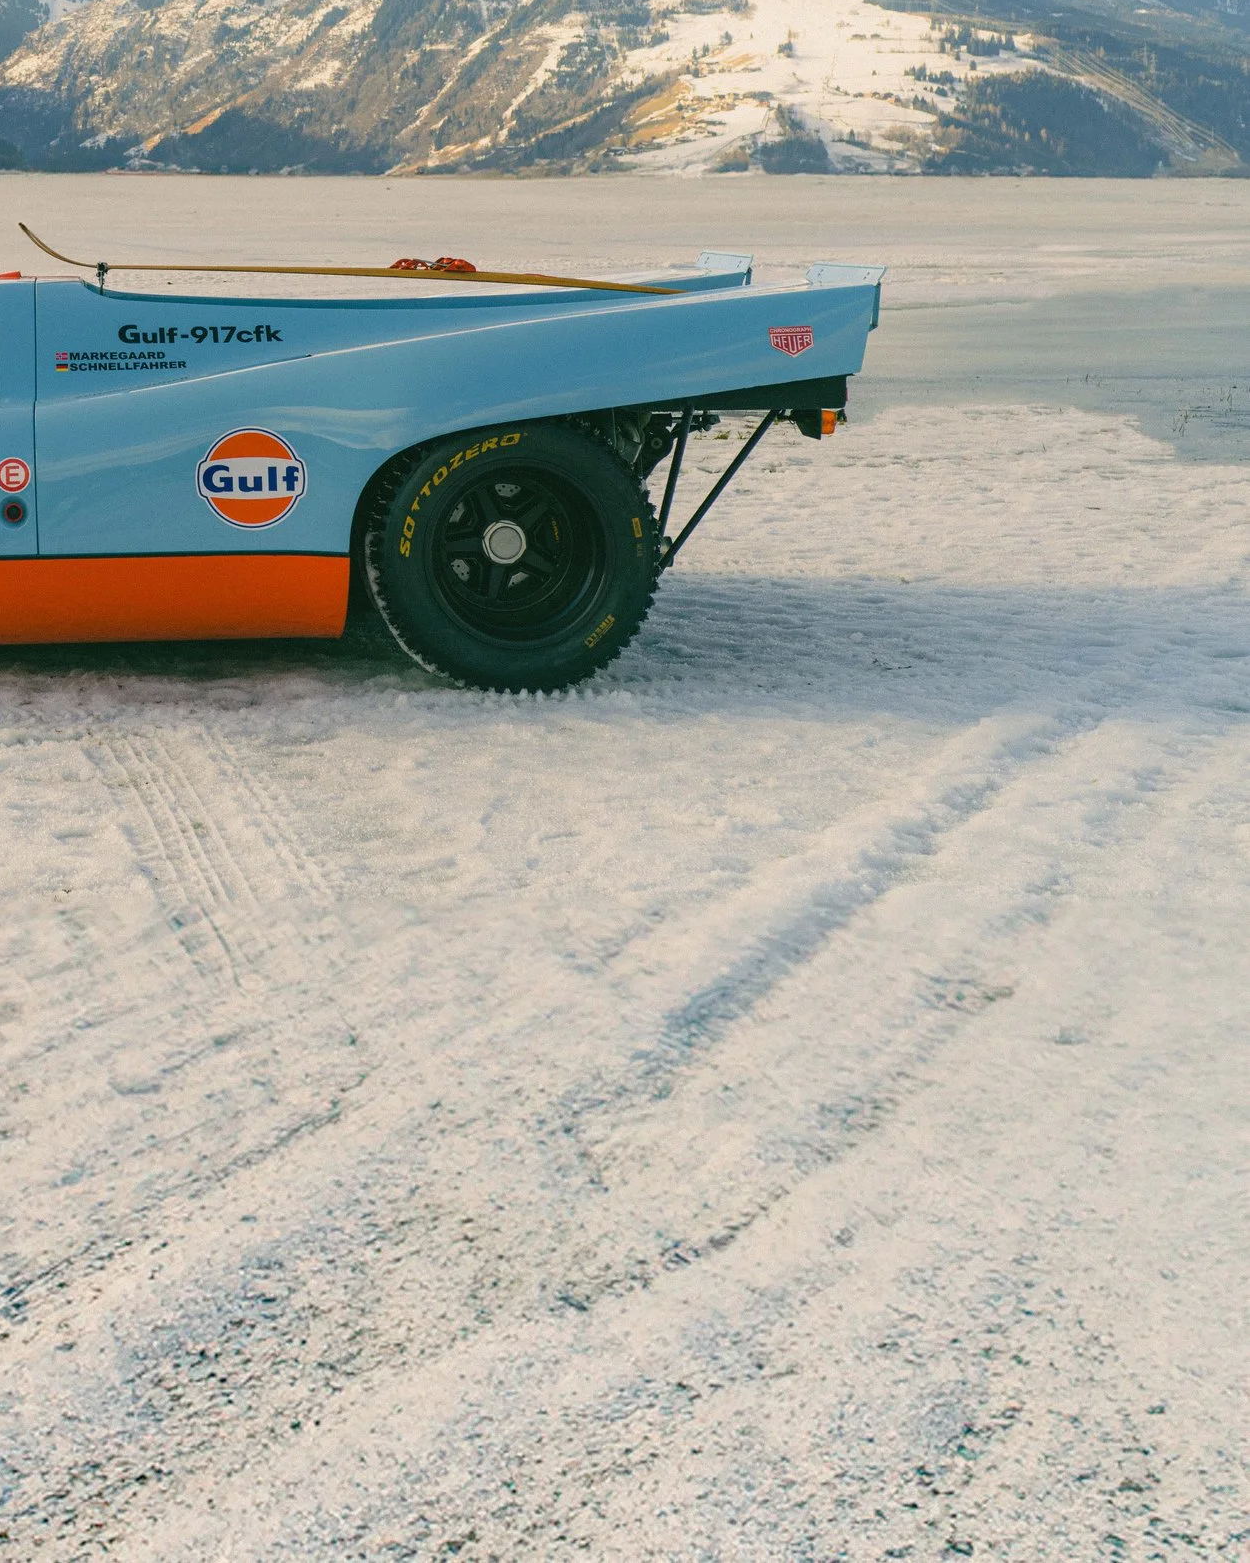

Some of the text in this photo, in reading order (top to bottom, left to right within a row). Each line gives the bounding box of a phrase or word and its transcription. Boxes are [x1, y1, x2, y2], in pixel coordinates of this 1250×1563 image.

[117, 324, 284, 345] Gulf-917cfk
[773, 335, 812, 353] HEUER
[69, 351, 166, 361] MARKEGAARD
[69, 360, 187, 372] SCHNELLFAHRER
[5, 465, 21, 485] E
[202, 465, 300, 494] Gulf
[399, 432, 521, 558] SOTTOZERO
